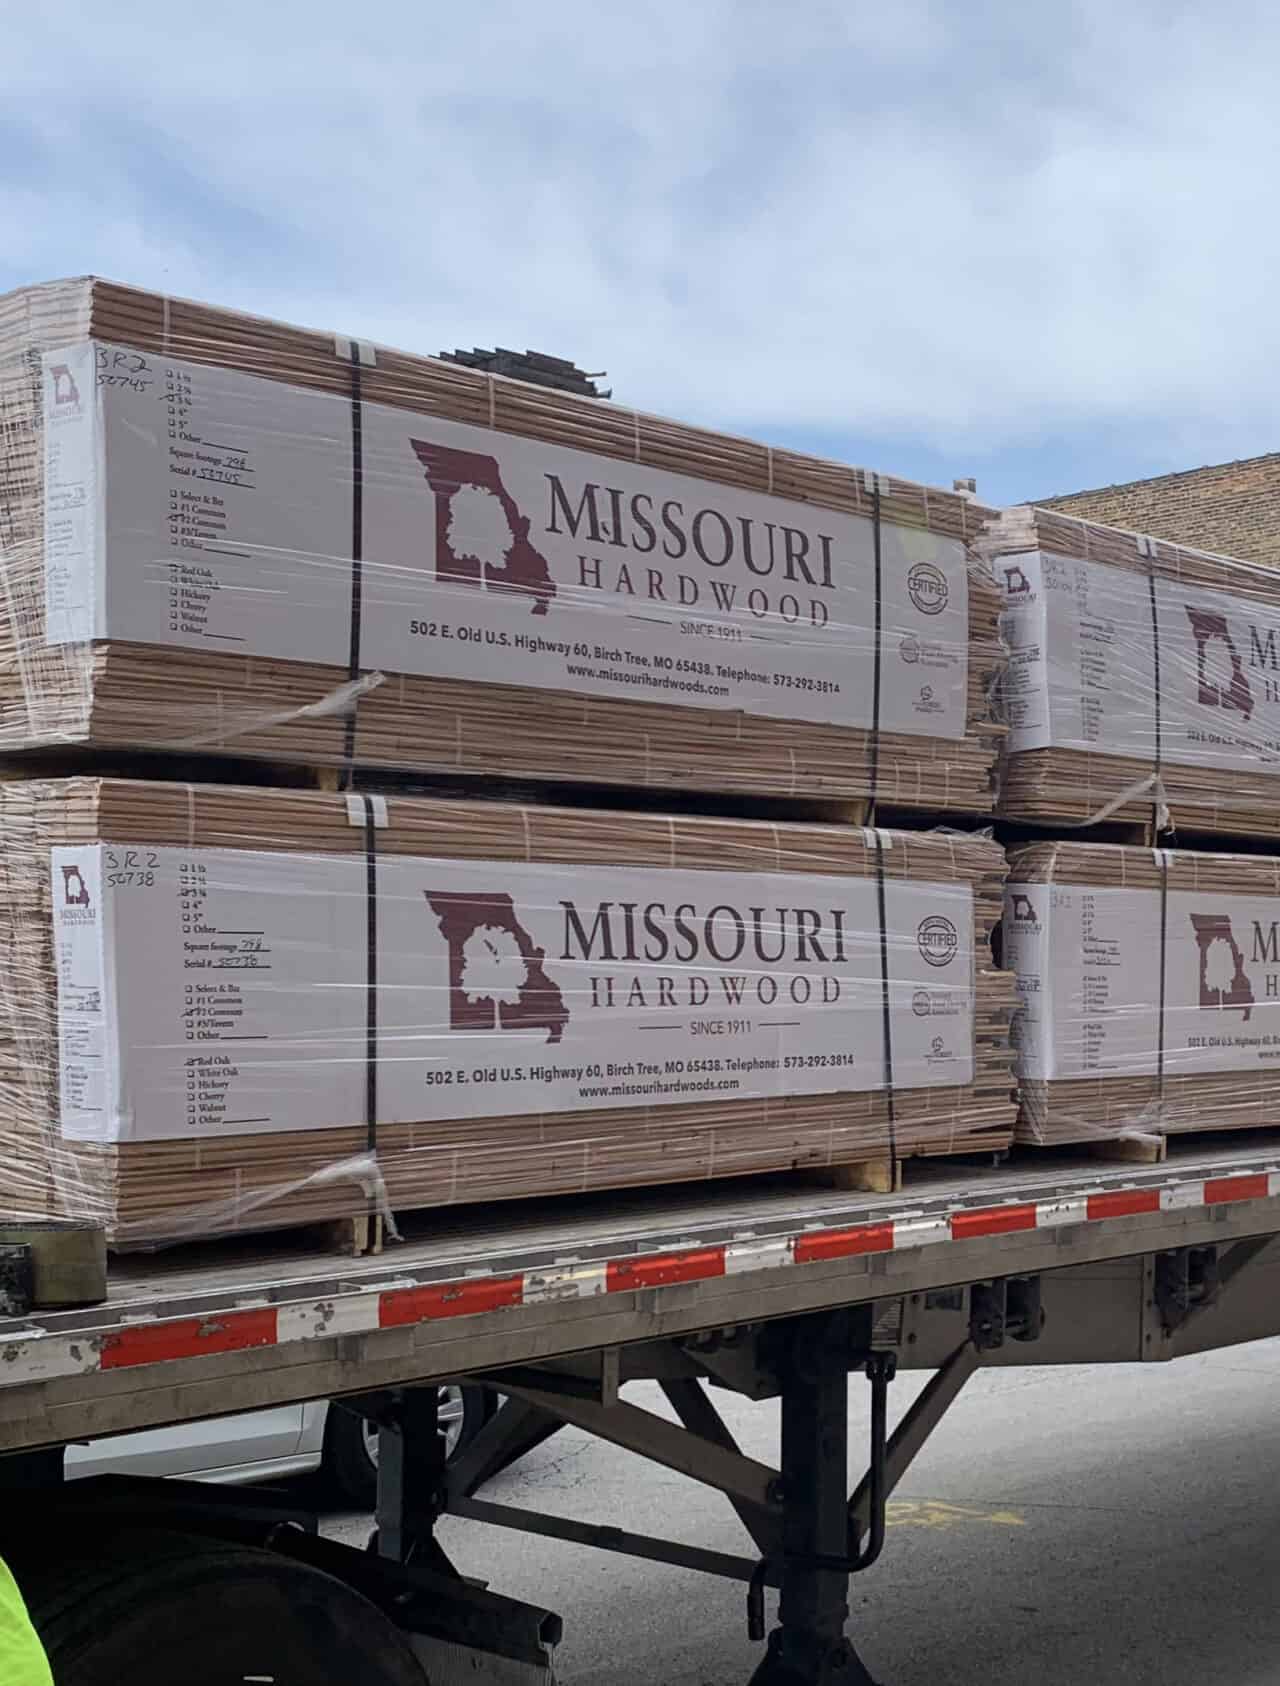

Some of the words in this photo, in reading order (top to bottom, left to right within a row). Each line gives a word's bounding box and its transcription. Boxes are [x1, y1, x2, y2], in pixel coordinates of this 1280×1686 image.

[543, 472, 837, 590] MISSOURI
[577, 555, 829, 628] HARDWOOD
[410, 620, 437, 637] 502
[441, 625, 454, 639] E.
[457, 626, 482, 643] Old
[485, 630, 512, 647] U.S.
[514, 634, 571, 657] Highway
[574, 643, 592, 660] 60,
[594, 646, 623, 663] Birch
[653, 655, 673, 670] MO
[716, 665, 771, 684] Telephone:
[773, 674, 840, 694] 573-292-3814
[566, 663, 729, 696] www.missourihardwoods.com
[559, 901, 849, 963] MISSOURI
[589, 975, 841, 1008] HARDWOOD
[690, 1021, 724, 1036] SINCE
[727, 1020, 752, 1034] 1911
[426, 1071, 453, 1085] 502
[456, 1071, 470, 1084] E.
[473, 1068, 497, 1083] Old
[501, 1068, 527, 1081] U.S.
[530, 1065, 583, 1083] Highway
[585, 1064, 604, 1079] 60,
[607, 1063, 634, 1077] Birch
[636, 1062, 662, 1076] Tree,
[665, 1061, 684, 1074] MO
[726, 1058, 780, 1073] Telephone:
[783, 1054, 854, 1068] 573-292-3814
[579, 1079, 740, 1097] www.missourihardwoods.com
